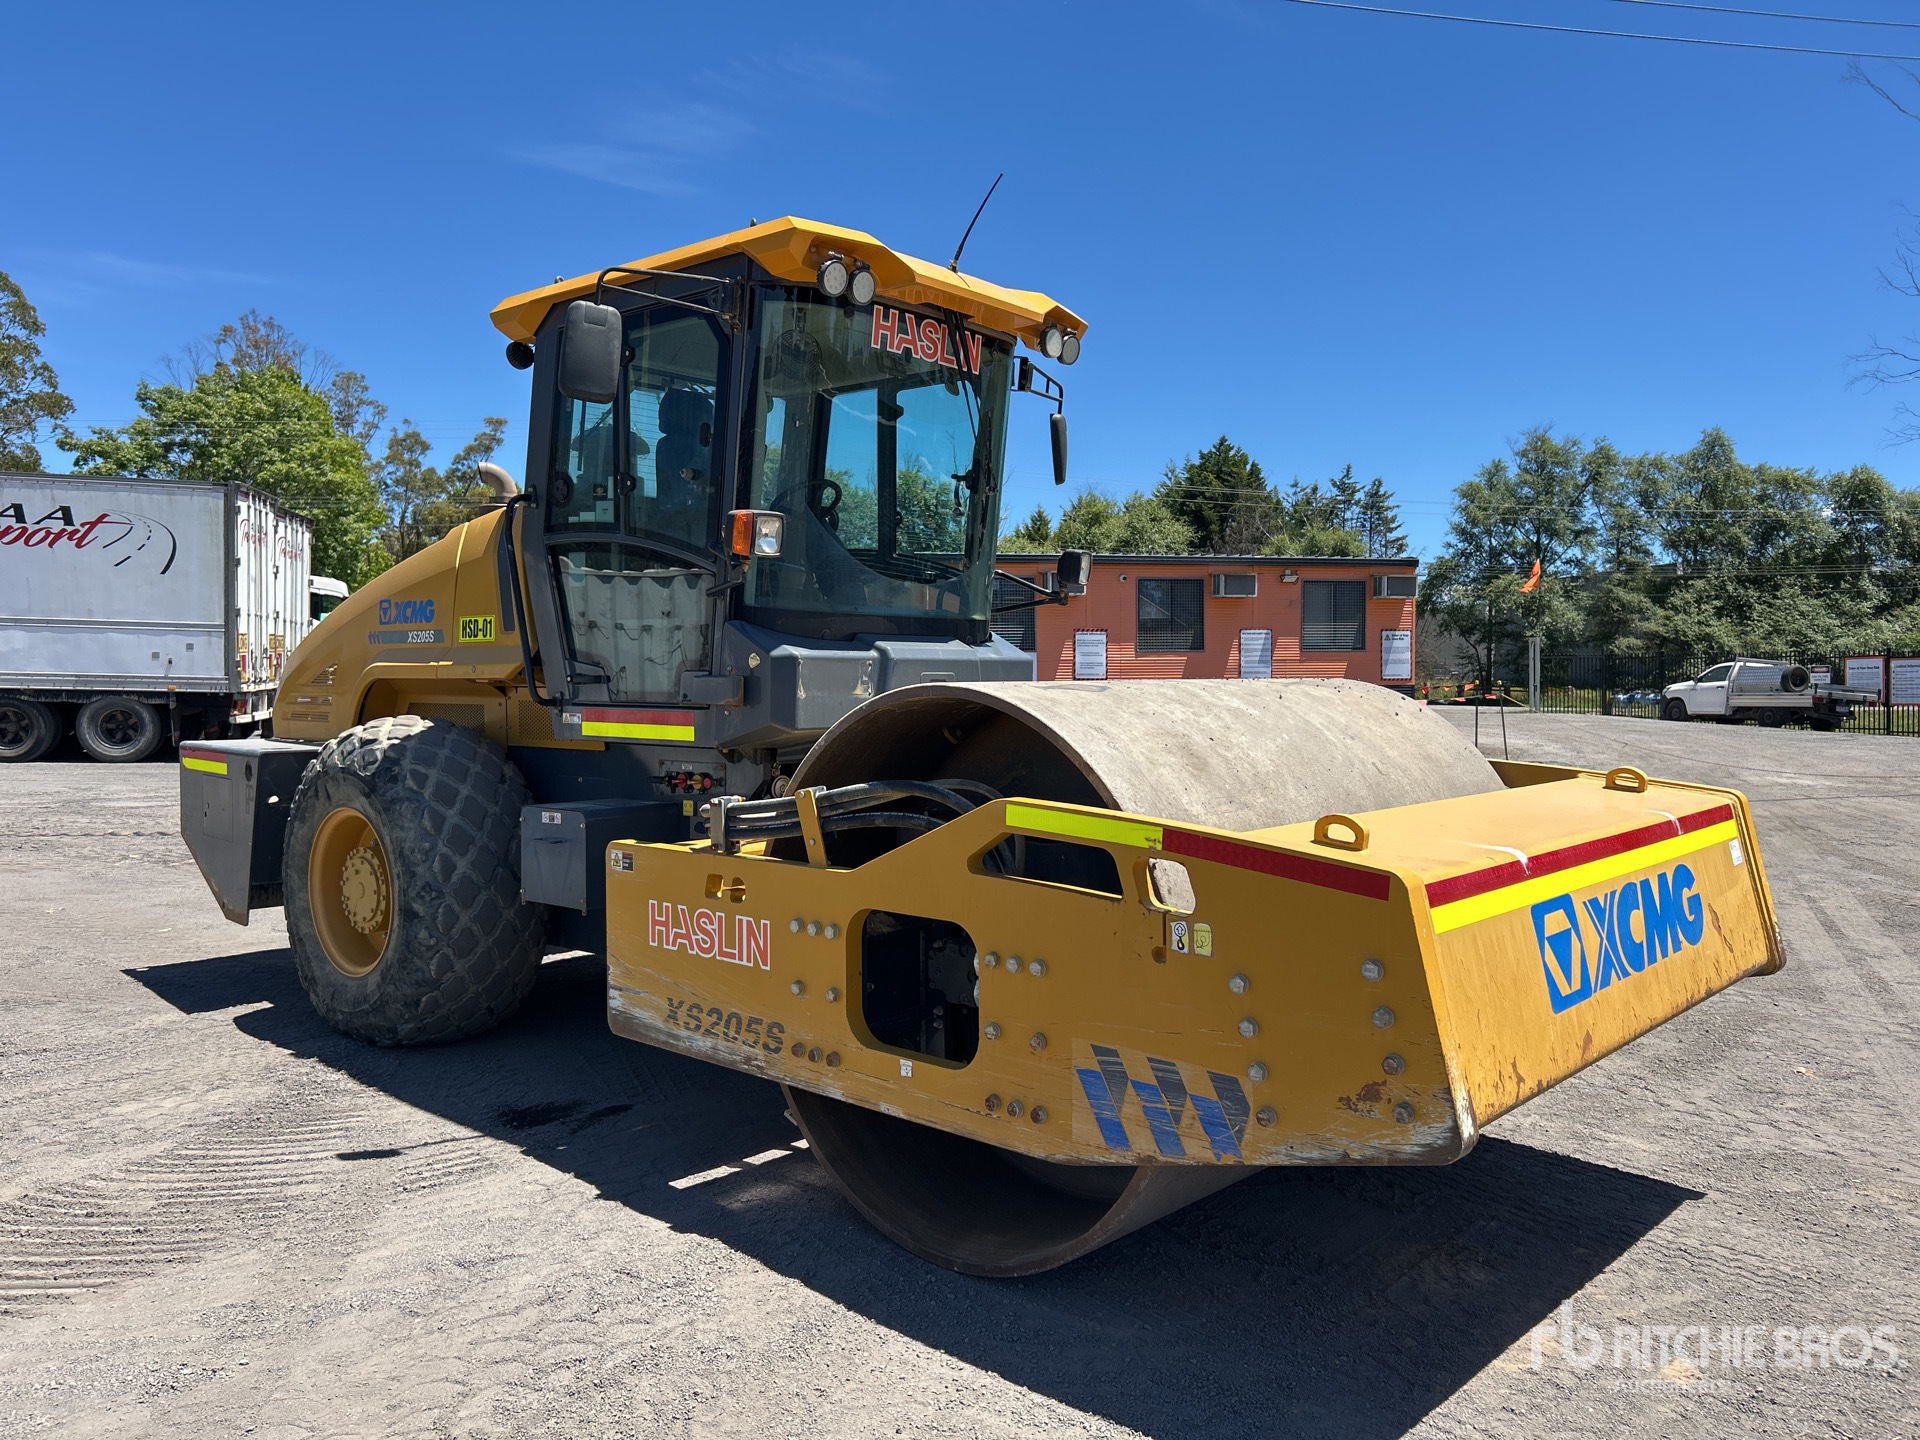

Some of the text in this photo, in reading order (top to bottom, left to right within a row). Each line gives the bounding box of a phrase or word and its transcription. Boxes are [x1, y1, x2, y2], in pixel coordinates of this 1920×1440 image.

[391, 599, 435, 624] XCMG
[461, 618, 493, 639] HSD-01
[407, 630, 435, 643] XS205S
[649, 900, 771, 971] HASLIN
[1582, 863, 1704, 995] XCMG
[666, 996, 785, 1055] XS205S
